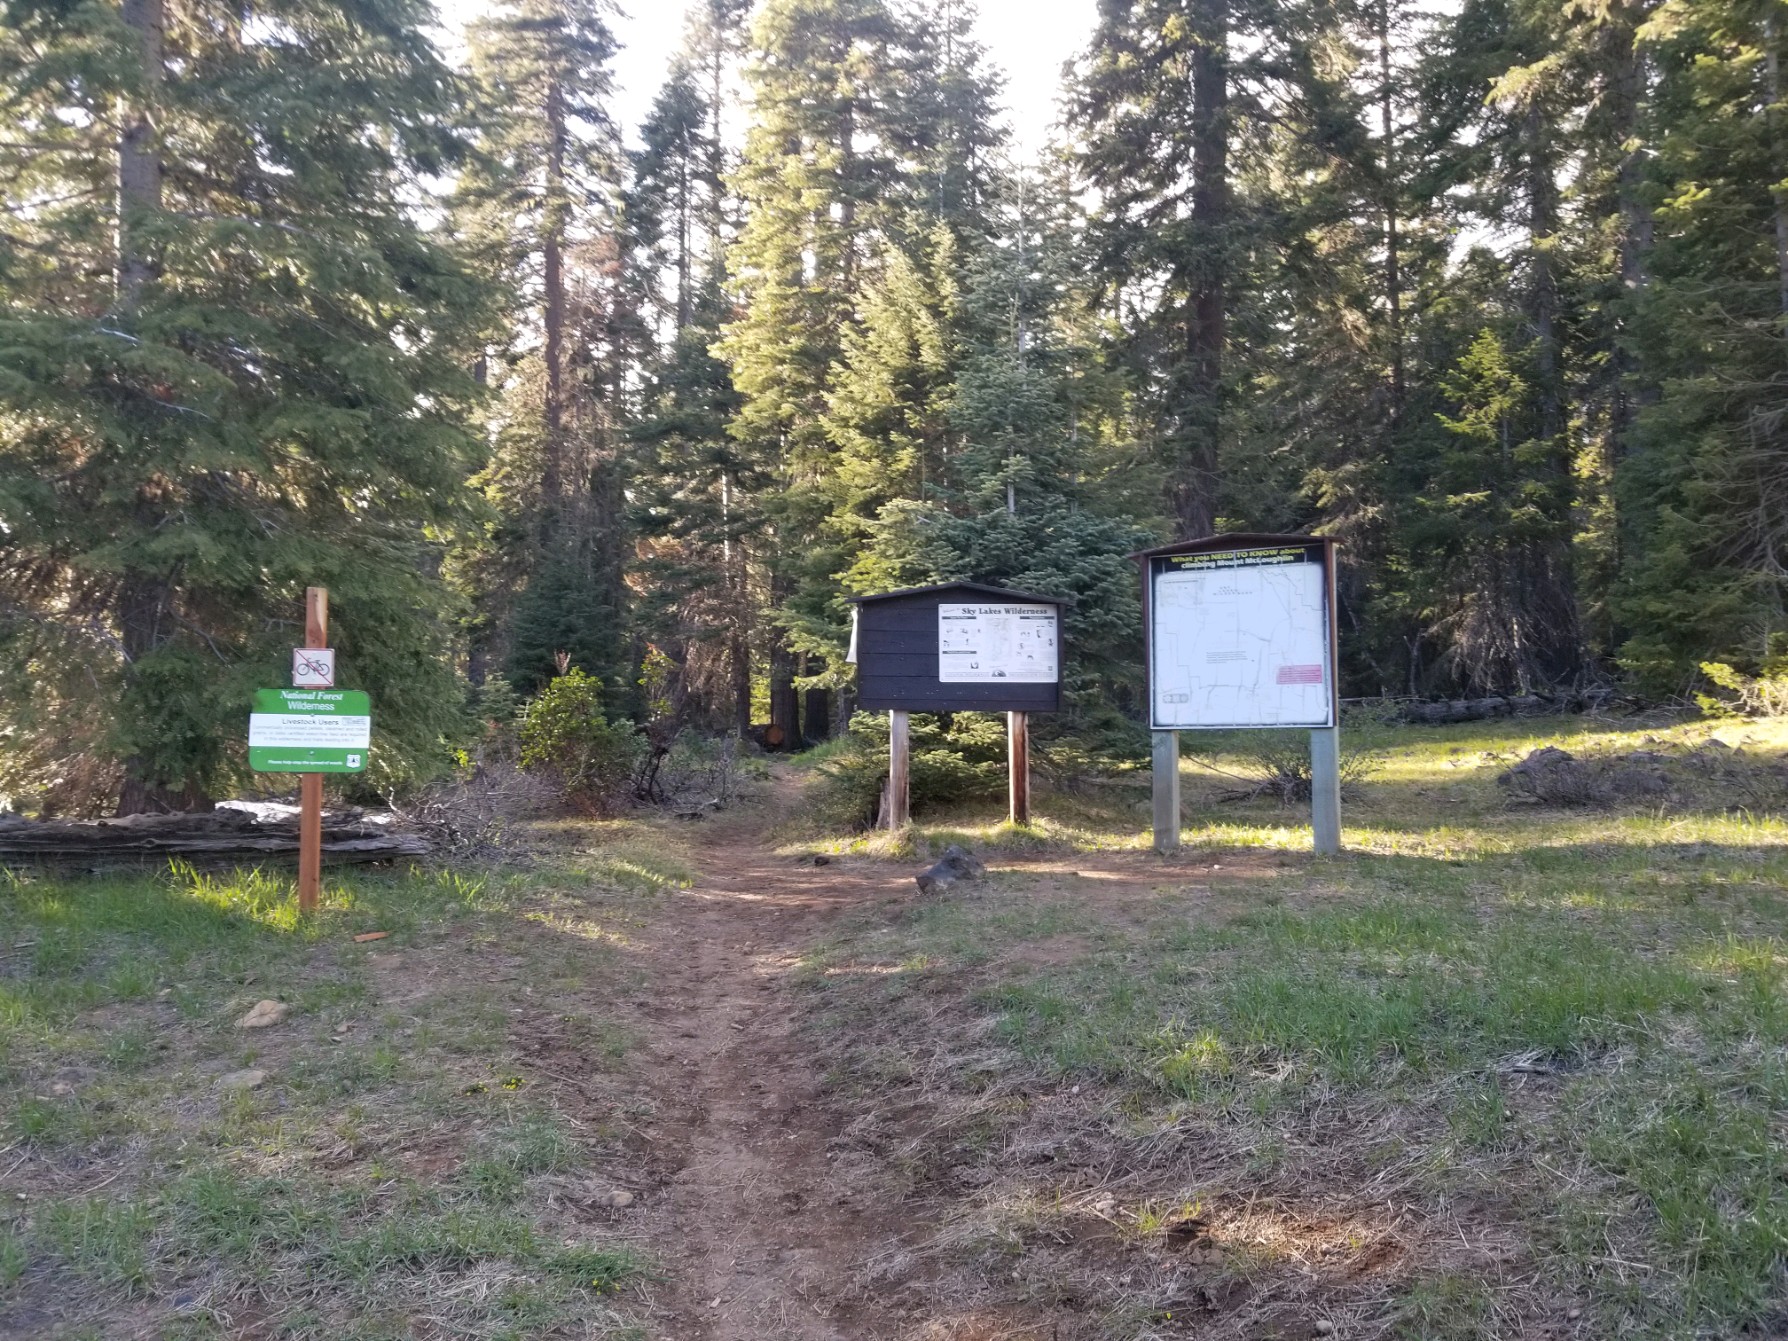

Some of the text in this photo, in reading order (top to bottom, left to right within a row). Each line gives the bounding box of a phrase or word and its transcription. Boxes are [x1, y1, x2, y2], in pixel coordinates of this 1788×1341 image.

[1193, 554, 1210, 563] you
[1210, 552, 1234, 560] NEED
[1249, 549, 1279, 557] KNOW
[1279, 547, 1306, 555] about
[1180, 561, 1216, 569] climbing
[1245, 555, 1294, 564] McLoughlin
[961, 607, 977, 615] Sky
[979, 607, 1002, 615] Lakes
[1004, 607, 1048, 615] Wilderness
[280, 690, 344, 701] National Forest
[287, 700, 335, 711] Wilderness
[282, 718, 316, 726] Livestock
